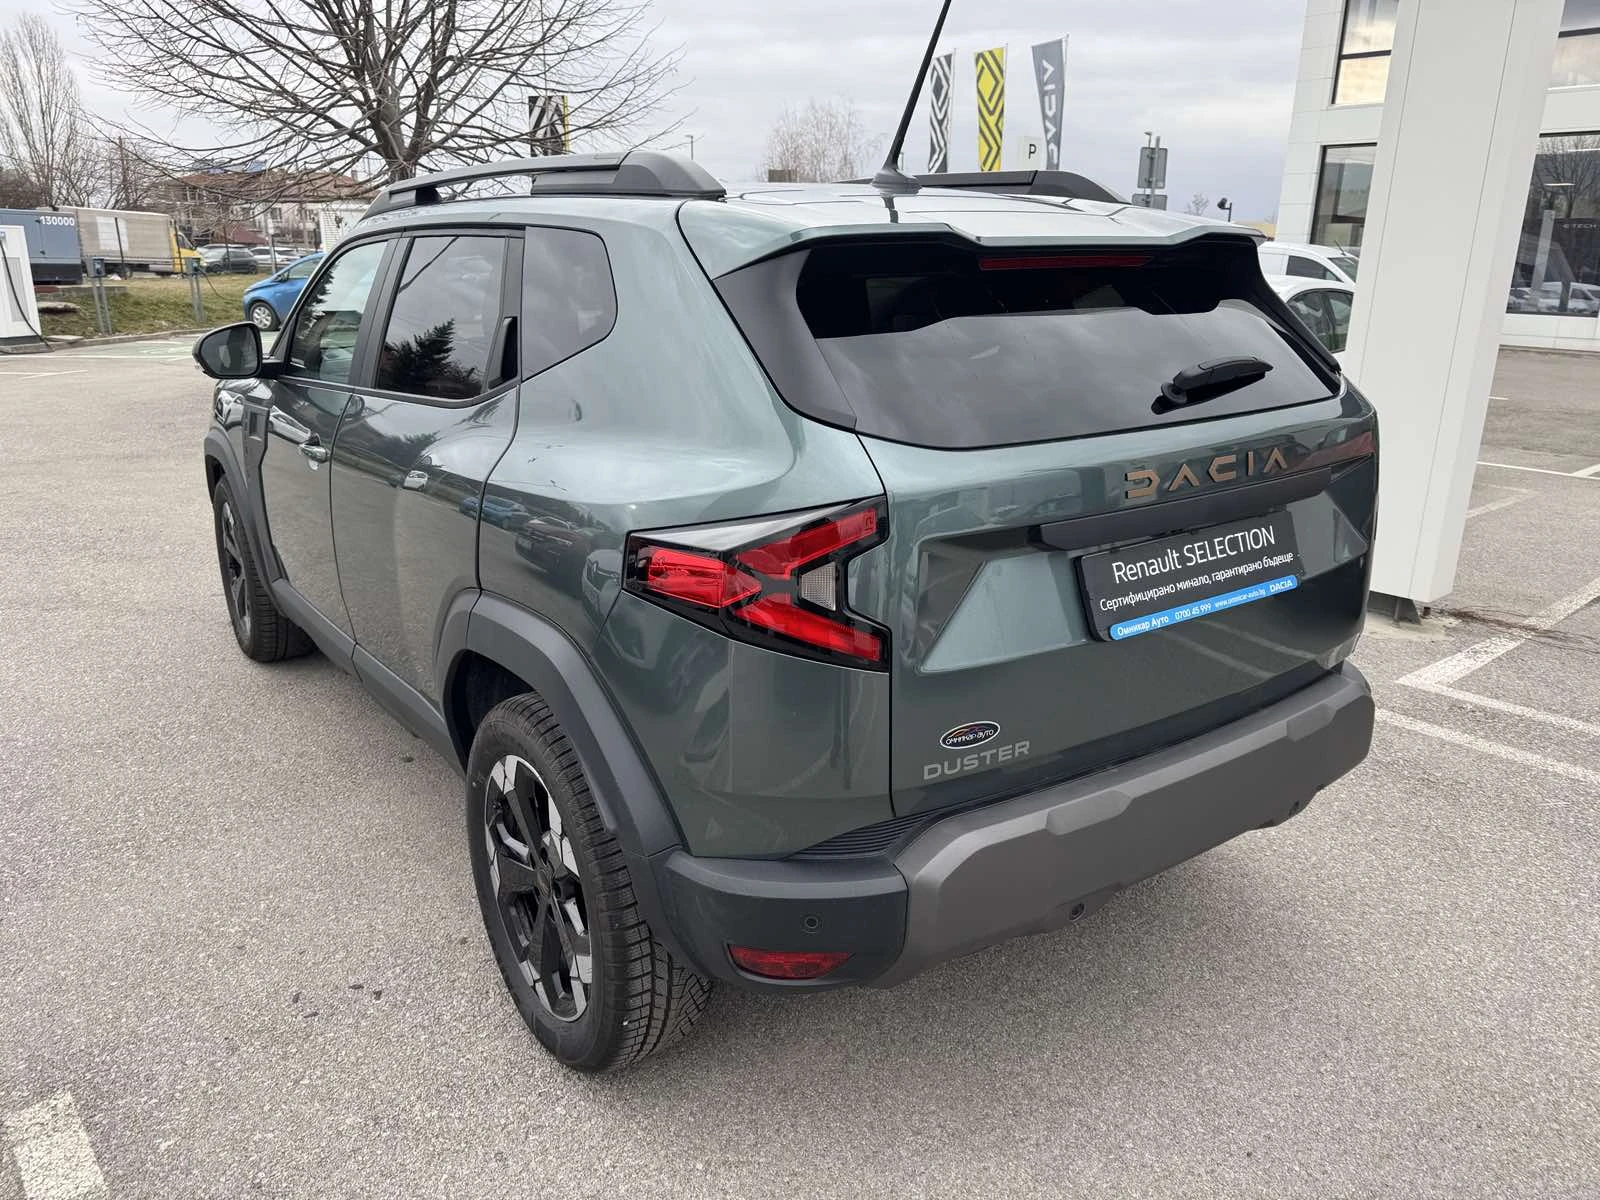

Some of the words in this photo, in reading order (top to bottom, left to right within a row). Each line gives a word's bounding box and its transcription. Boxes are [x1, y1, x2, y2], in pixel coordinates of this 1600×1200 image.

[1028, 143, 1037, 160] P
[1125, 448, 1288, 499] DACIA
[1112, 548, 1182, 584] Renault
[1184, 525, 1275, 566] SELECTION
[1100, 584, 1176, 611] Сертифицирано
[1176, 575, 1211, 591] минало,
[1212, 561, 1262, 582] гарантирано
[1262, 552, 1294, 568] бъдеще
[1151, 615, 1169, 628] Ауто
[1175, 610, 1191, 620] 0700
[1269, 579, 1293, 592] DACIA
[923, 740, 1031, 780] DUSTER
